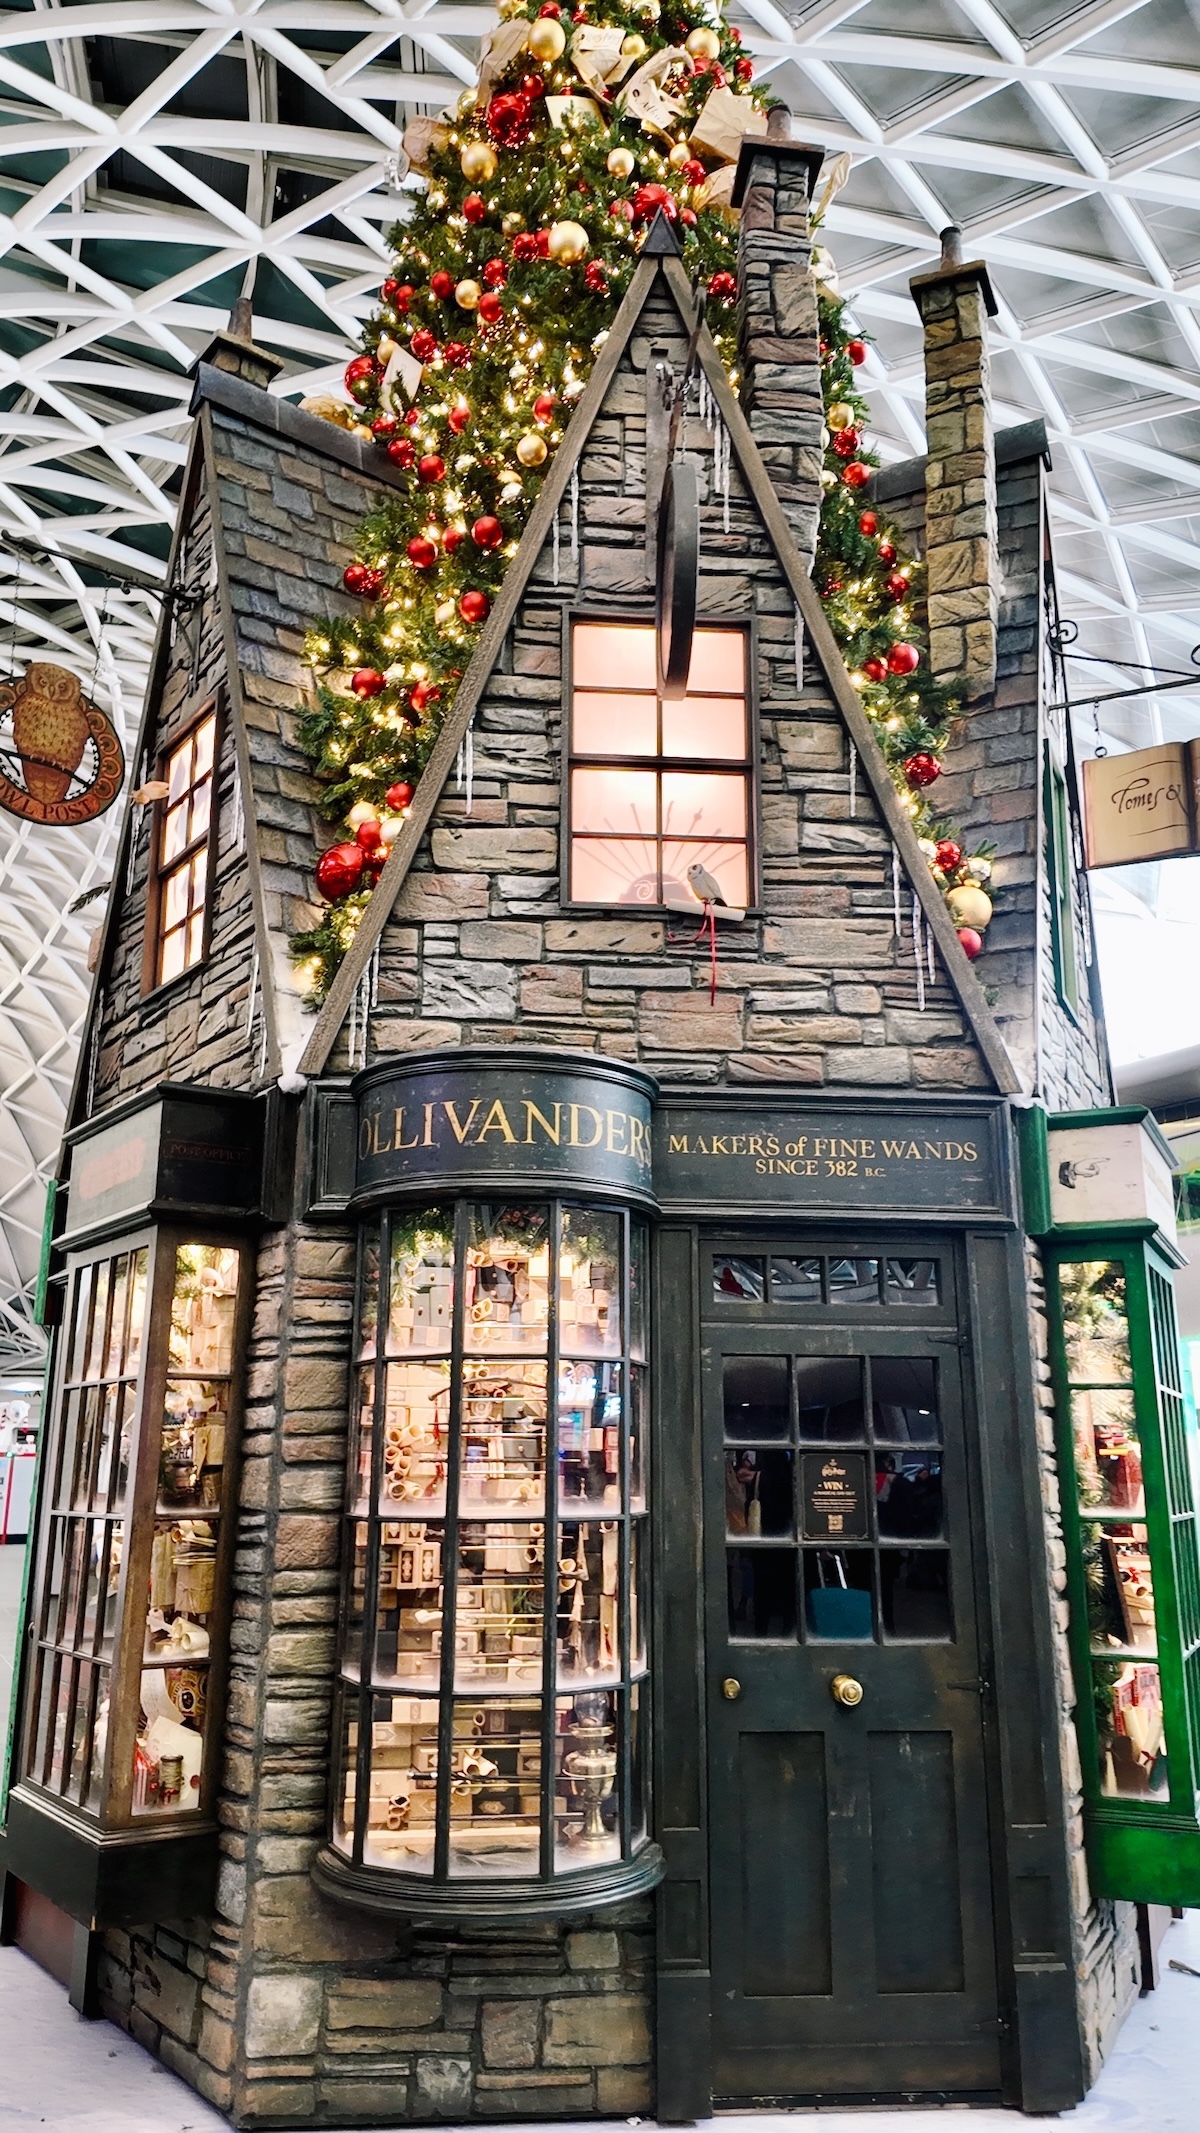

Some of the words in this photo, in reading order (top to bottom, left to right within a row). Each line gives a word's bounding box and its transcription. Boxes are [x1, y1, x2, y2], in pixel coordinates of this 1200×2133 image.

[1111, 777, 1165, 813] Tomes
[1166, 784, 1189, 817] &
[42, 799, 93, 821] POST
[358, 1098, 652, 1168] OLLIVANDERS
[170, 1143, 201, 1156] POST
[667, 1134, 780, 1157] MAKERS
[785, 1136, 809, 1157] of
[814, 1138, 876, 1160] FINE
[877, 1140, 978, 1162] WANDS
[755, 1158, 818, 1176] SINCE
[825, 1160, 858, 1178] 382
[823, 1481, 843, 1490] WIN
